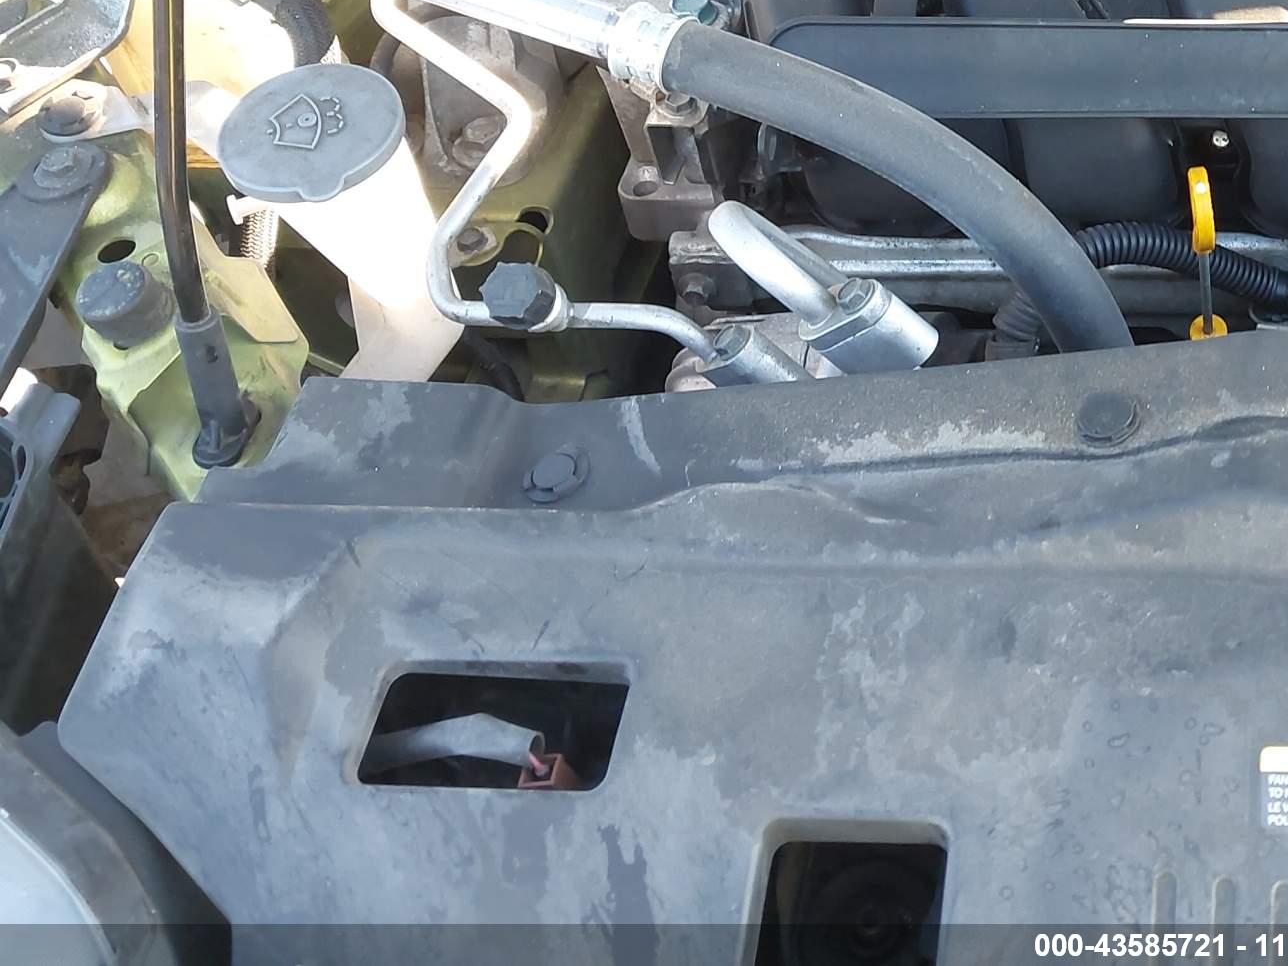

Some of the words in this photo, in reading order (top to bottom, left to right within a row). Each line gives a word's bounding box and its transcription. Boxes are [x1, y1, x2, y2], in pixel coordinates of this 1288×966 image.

[1268, 774, 1288, 786] FAN
[1268, 787, 1284, 798] TO
[1268, 801, 1281, 813] LE
